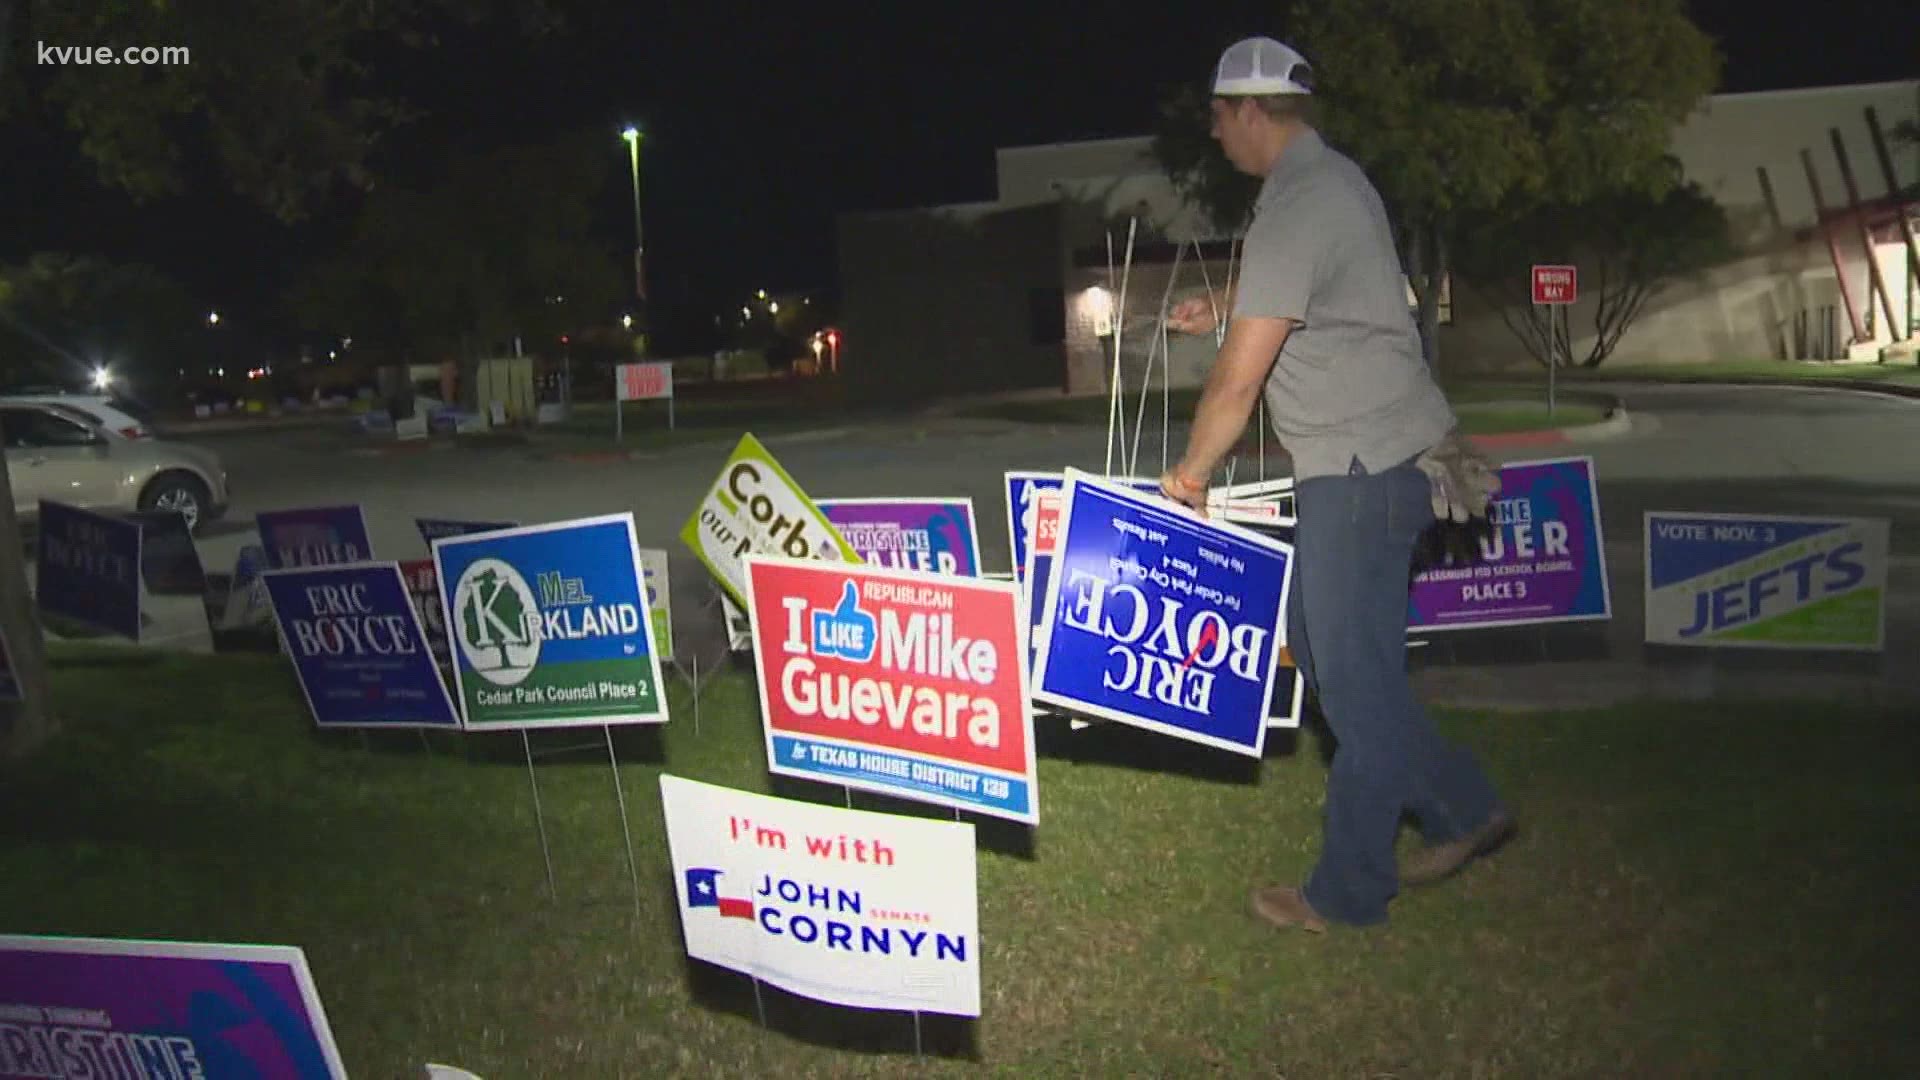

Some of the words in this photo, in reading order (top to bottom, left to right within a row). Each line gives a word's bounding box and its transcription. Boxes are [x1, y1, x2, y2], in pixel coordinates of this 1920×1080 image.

[1544, 287, 1564, 297] WAY
[729, 462, 821, 560] Corb
[1111, 516, 1149, 543] Results
[1147, 529, 1169, 547] Just
[1656, 522, 1707, 541] VOTE
[1763, 527, 1777, 543] 3
[1171, 556, 1198, 578] Place
[1197, 545, 1230, 570] Politics
[1230, 558, 1246, 575] No
[1494, 562, 1534, 577] SCHOOL
[1148, 566, 1170, 588] City
[1171, 574, 1194, 596] Park
[1678, 541, 1866, 639] JEFTS
[305, 582, 375, 617] ERIC
[863, 580, 954, 609] REPUBLICAN
[1195, 584, 1224, 605] Cedar
[1222, 595, 1241, 612] For
[1462, 582, 1512, 602] PLACE
[1515, 580, 1528, 599] 3
[292, 614, 416, 657] BOYCE
[1064, 567, 1269, 682] BOYCE
[782, 596, 808, 654] I
[819, 620, 865, 650] LIKE
[880, 607, 999, 686] Mike
[476, 688, 513, 706] Cedar
[516, 686, 546, 704] Park
[546, 684, 597, 702] Council
[599, 682, 636, 698] Place
[639, 679, 649, 697] 2
[1103, 644, 1217, 715] ERIC
[781, 656, 1001, 749] Guevara
[810, 744, 858, 769] TEXAS
[860, 752, 910, 777] HOUSE
[912, 763, 978, 794] DISTRICT
[728, 815, 788, 850] I'm
[805, 833, 895, 866] with
[756, 873, 863, 915] JOHN
[868, 907, 932, 923] SENATE
[758, 906, 967, 963] CORNYN
